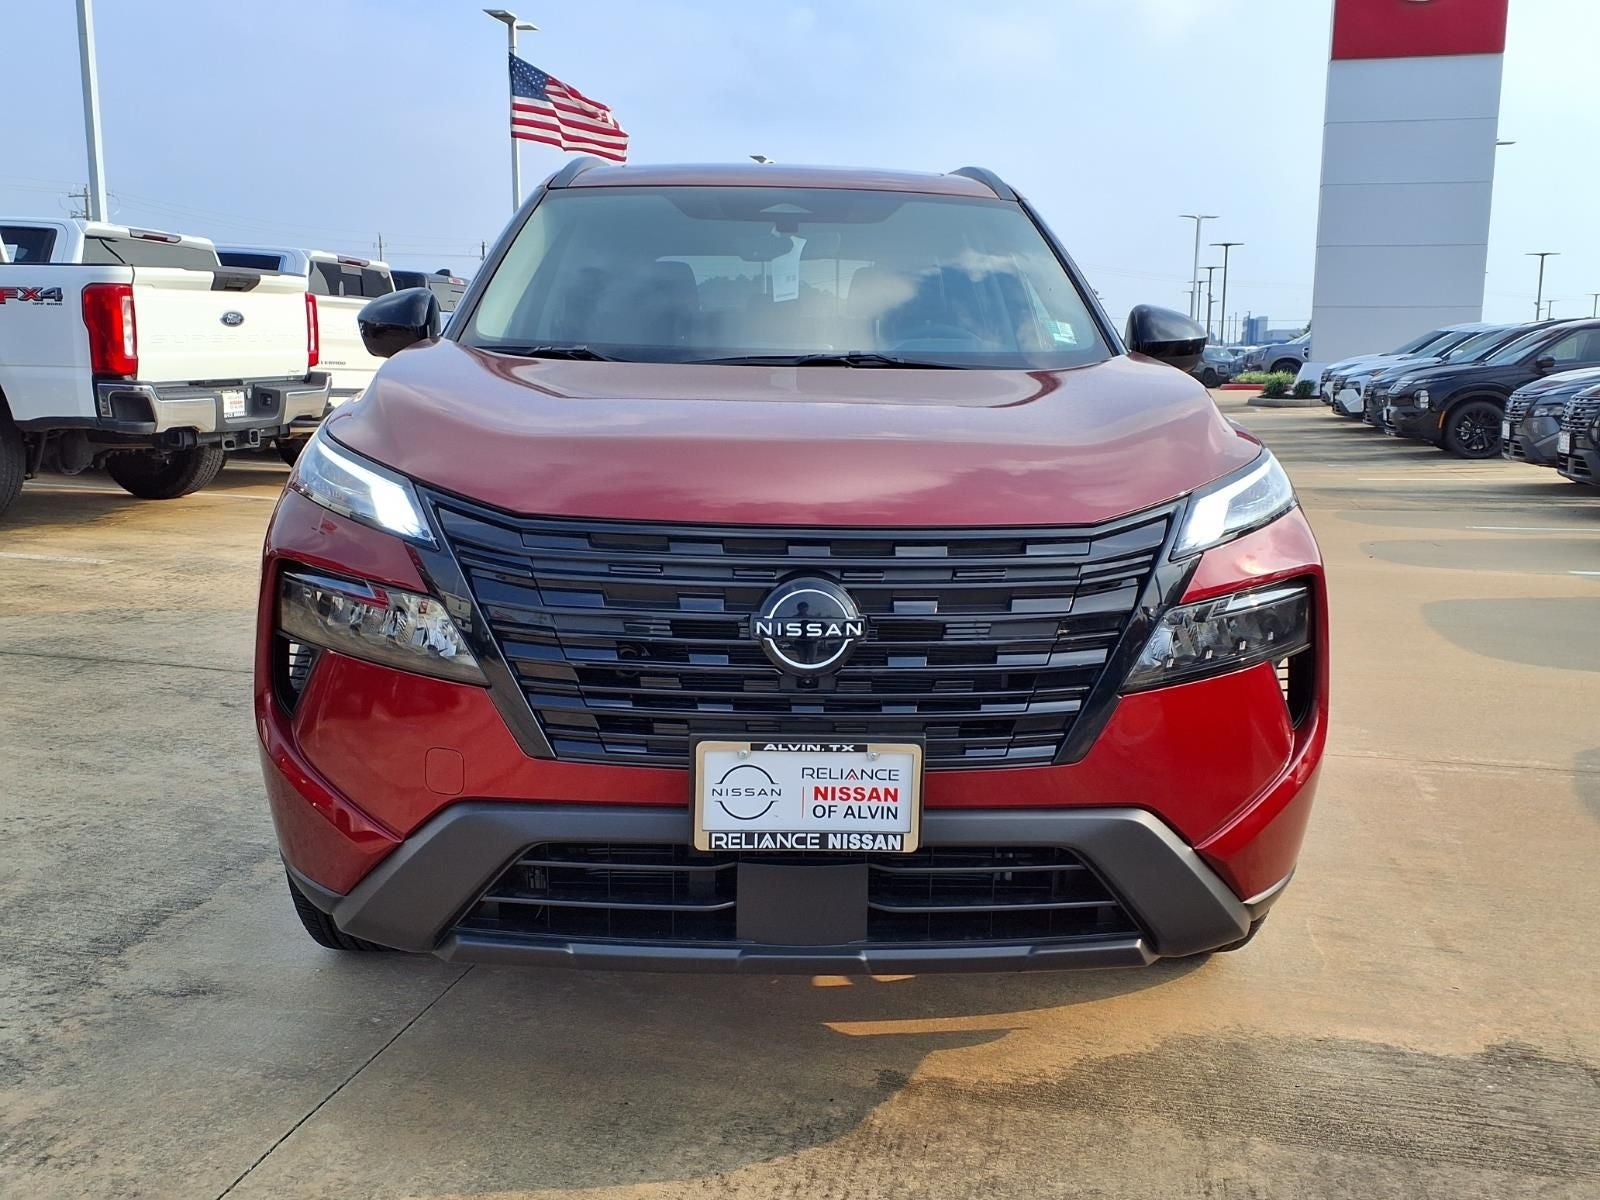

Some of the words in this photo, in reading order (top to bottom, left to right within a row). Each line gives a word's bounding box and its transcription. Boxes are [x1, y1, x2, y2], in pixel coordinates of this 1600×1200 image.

[0, 286, 63, 304] FX4
[756, 621, 862, 637] NISSAN
[829, 744, 855, 752] TX
[801, 767, 900, 782] RELIANCE
[712, 787, 782, 797] NISSAN
[813, 786, 899, 803] NISSAN
[812, 804, 838, 819] OF
[843, 806, 898, 820] ALVIN
[711, 832, 820, 849] RELIANCE
[828, 834, 901, 850] NISSAN
